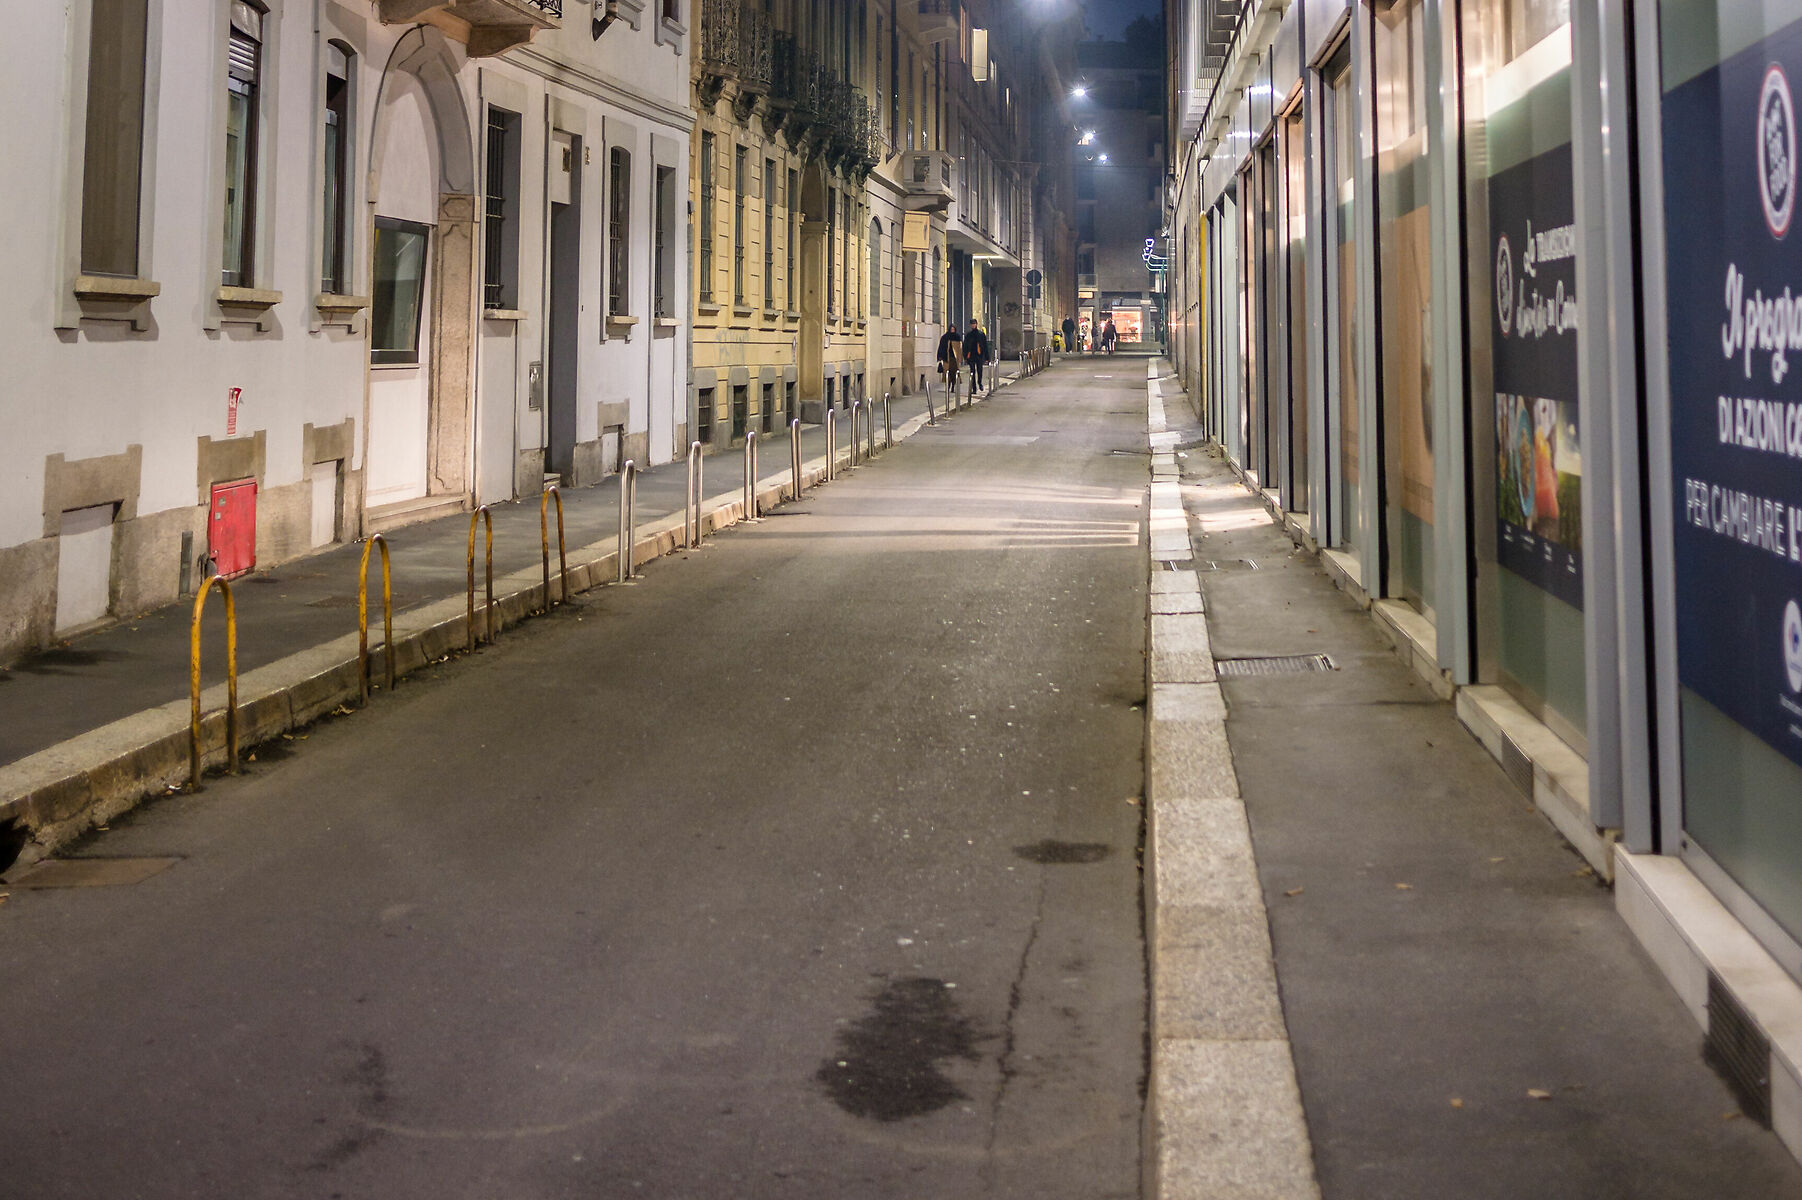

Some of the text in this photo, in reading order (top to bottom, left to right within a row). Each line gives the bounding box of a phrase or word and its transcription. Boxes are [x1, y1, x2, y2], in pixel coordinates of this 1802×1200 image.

[1722, 263, 1744, 359] Il
[1718, 396, 1734, 444] DI
[1735, 398, 1785, 454] AZIONI
[1686, 478, 1711, 529] PER
[1711, 484, 1786, 557] CAMBIARE
